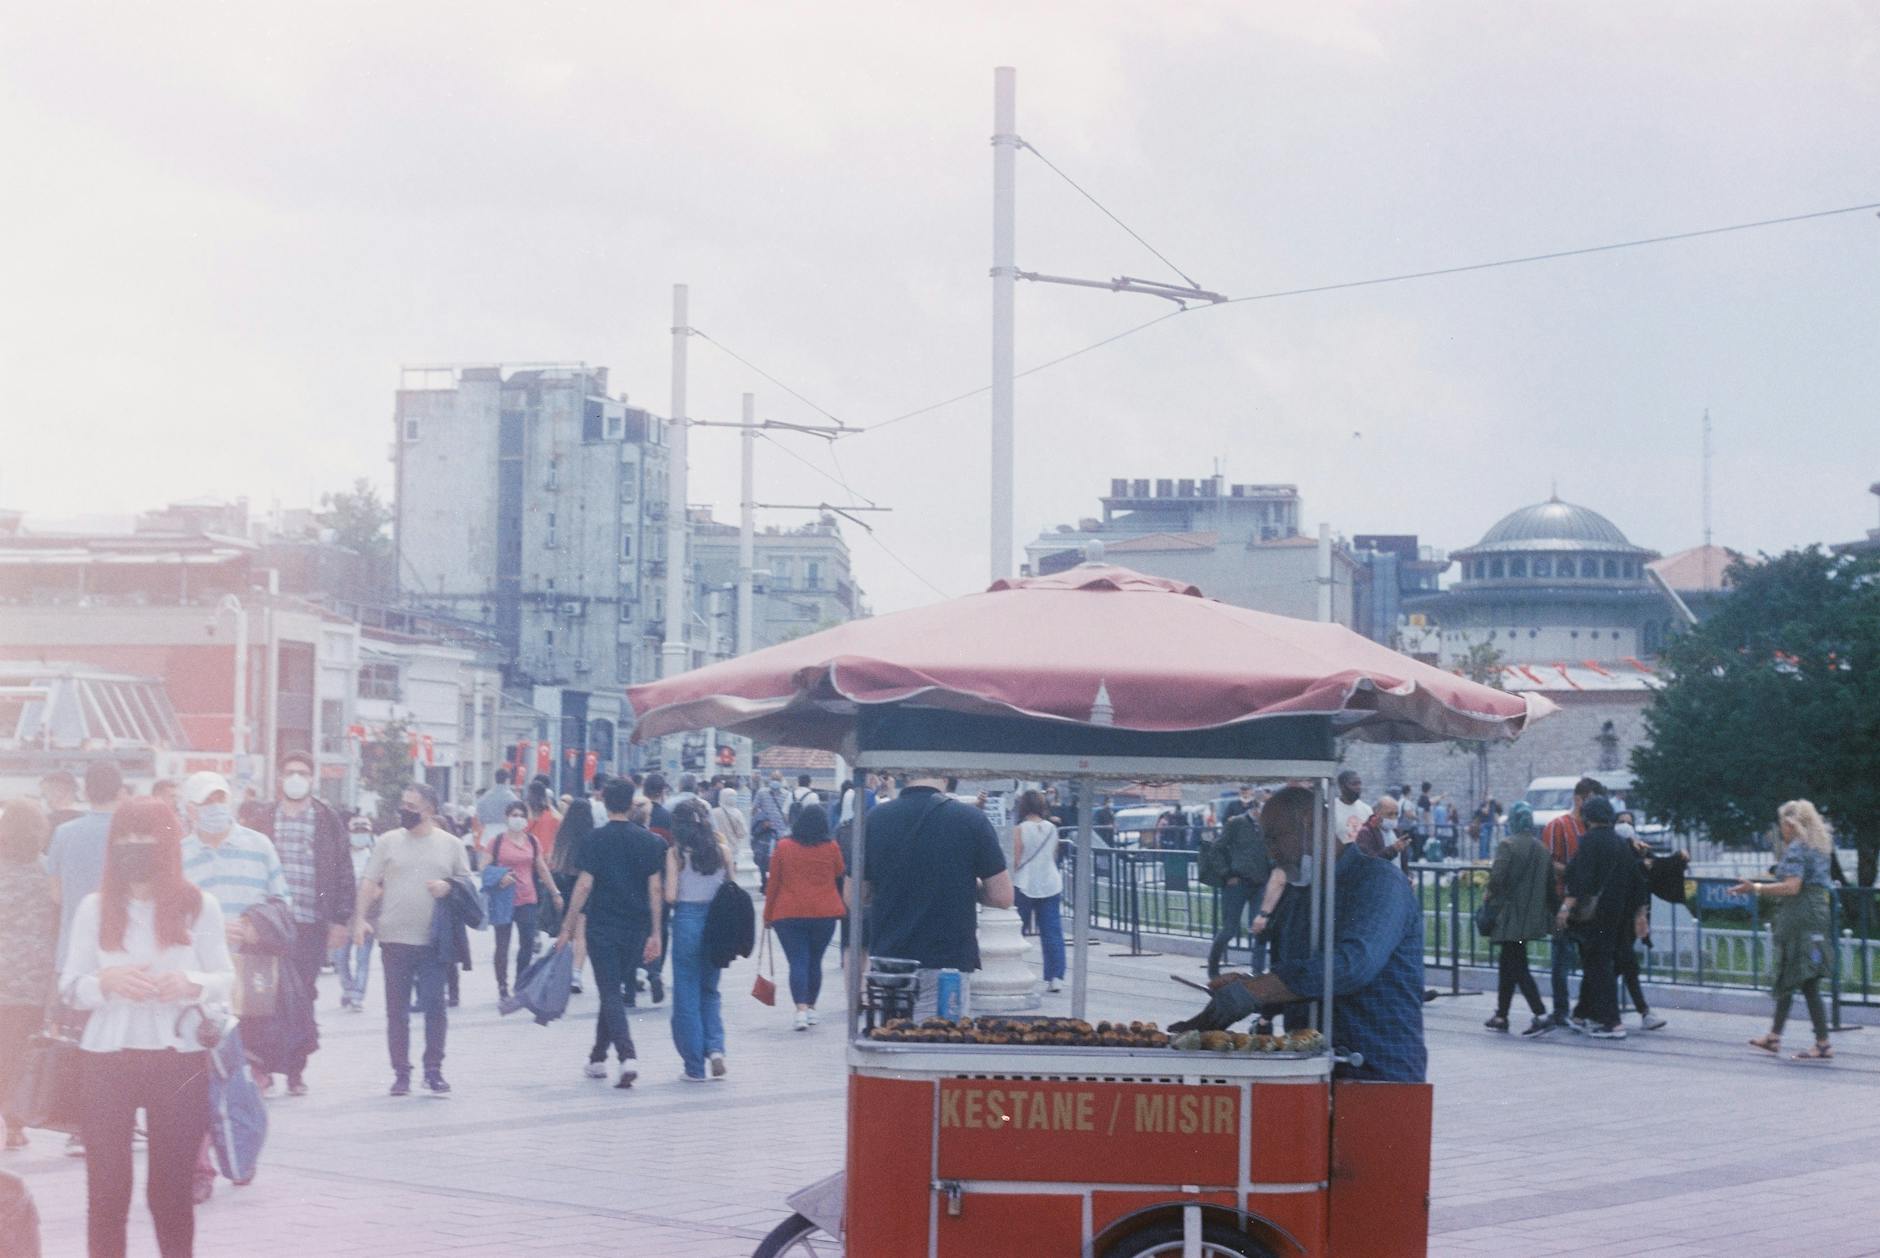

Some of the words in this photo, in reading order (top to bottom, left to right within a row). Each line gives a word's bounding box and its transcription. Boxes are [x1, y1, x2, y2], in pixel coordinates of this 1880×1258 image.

[941, 1088, 1095, 1131] KESTANE
[1107, 1093, 1121, 1136] /
[1134, 1093, 1236, 1135] MISIR
